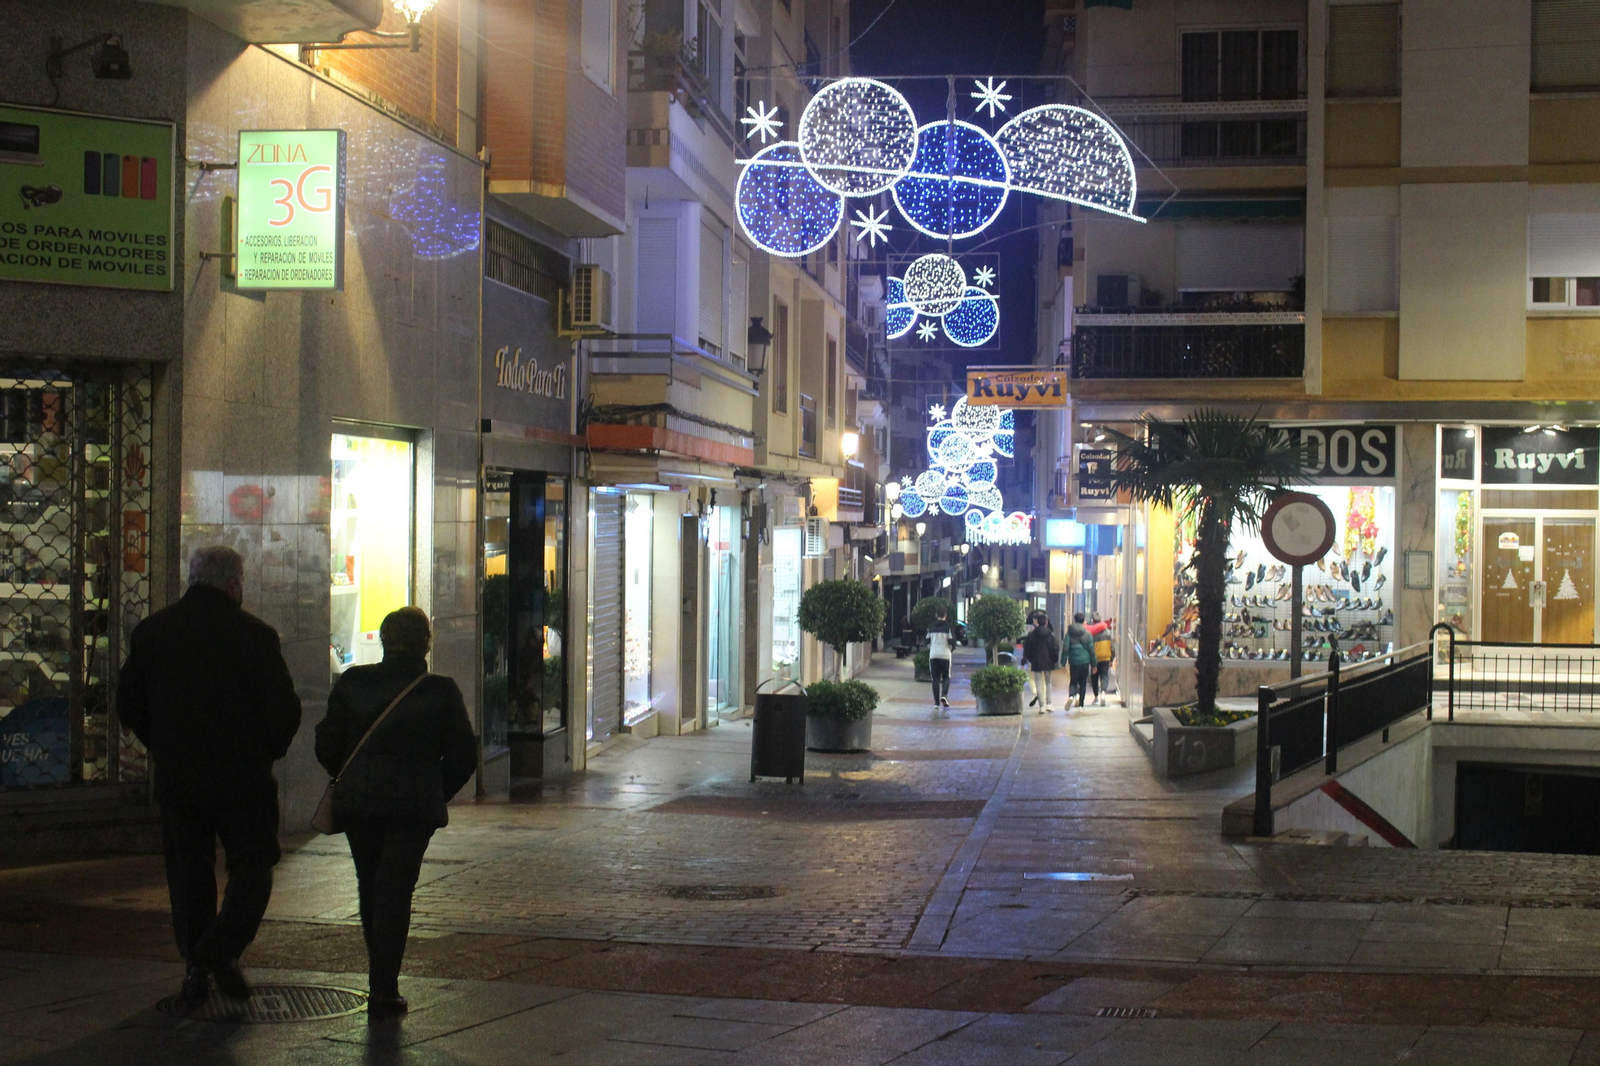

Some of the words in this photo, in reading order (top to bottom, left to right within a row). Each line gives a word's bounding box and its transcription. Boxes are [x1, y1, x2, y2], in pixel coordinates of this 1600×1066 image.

[247, 144, 308, 164] ZONA
[269, 165, 331, 226] 3G
[34, 224, 83, 240] PARA
[88, 230, 166, 246] MOVILES
[245, 235, 283, 248] ACCESORIOS,
[284, 235, 318, 247] LIBERACION
[0, 237, 20, 250] DE
[26, 239, 166, 262] ORDENADORES
[253, 252, 258, 264] Y
[261, 252, 296, 264] REPARACION
[298, 252, 307, 264] DE
[309, 252, 333, 264] MOVILES
[58, 257, 82, 269] DE
[88, 261, 166, 276] MOVILES
[244, 269, 280, 281] REPARACION
[282, 269, 289, 281] DE
[290, 269, 333, 281] ORDENADORES
[495, 345, 525, 391] Todo
[526, 358, 552, 398] Para
[996, 374, 1045, 383] Calzados
[972, 377, 1062, 401] Ruyvi
[1494, 447, 1586, 474] Ruyvi
[1080, 486, 1110, 497] Ruyvi
